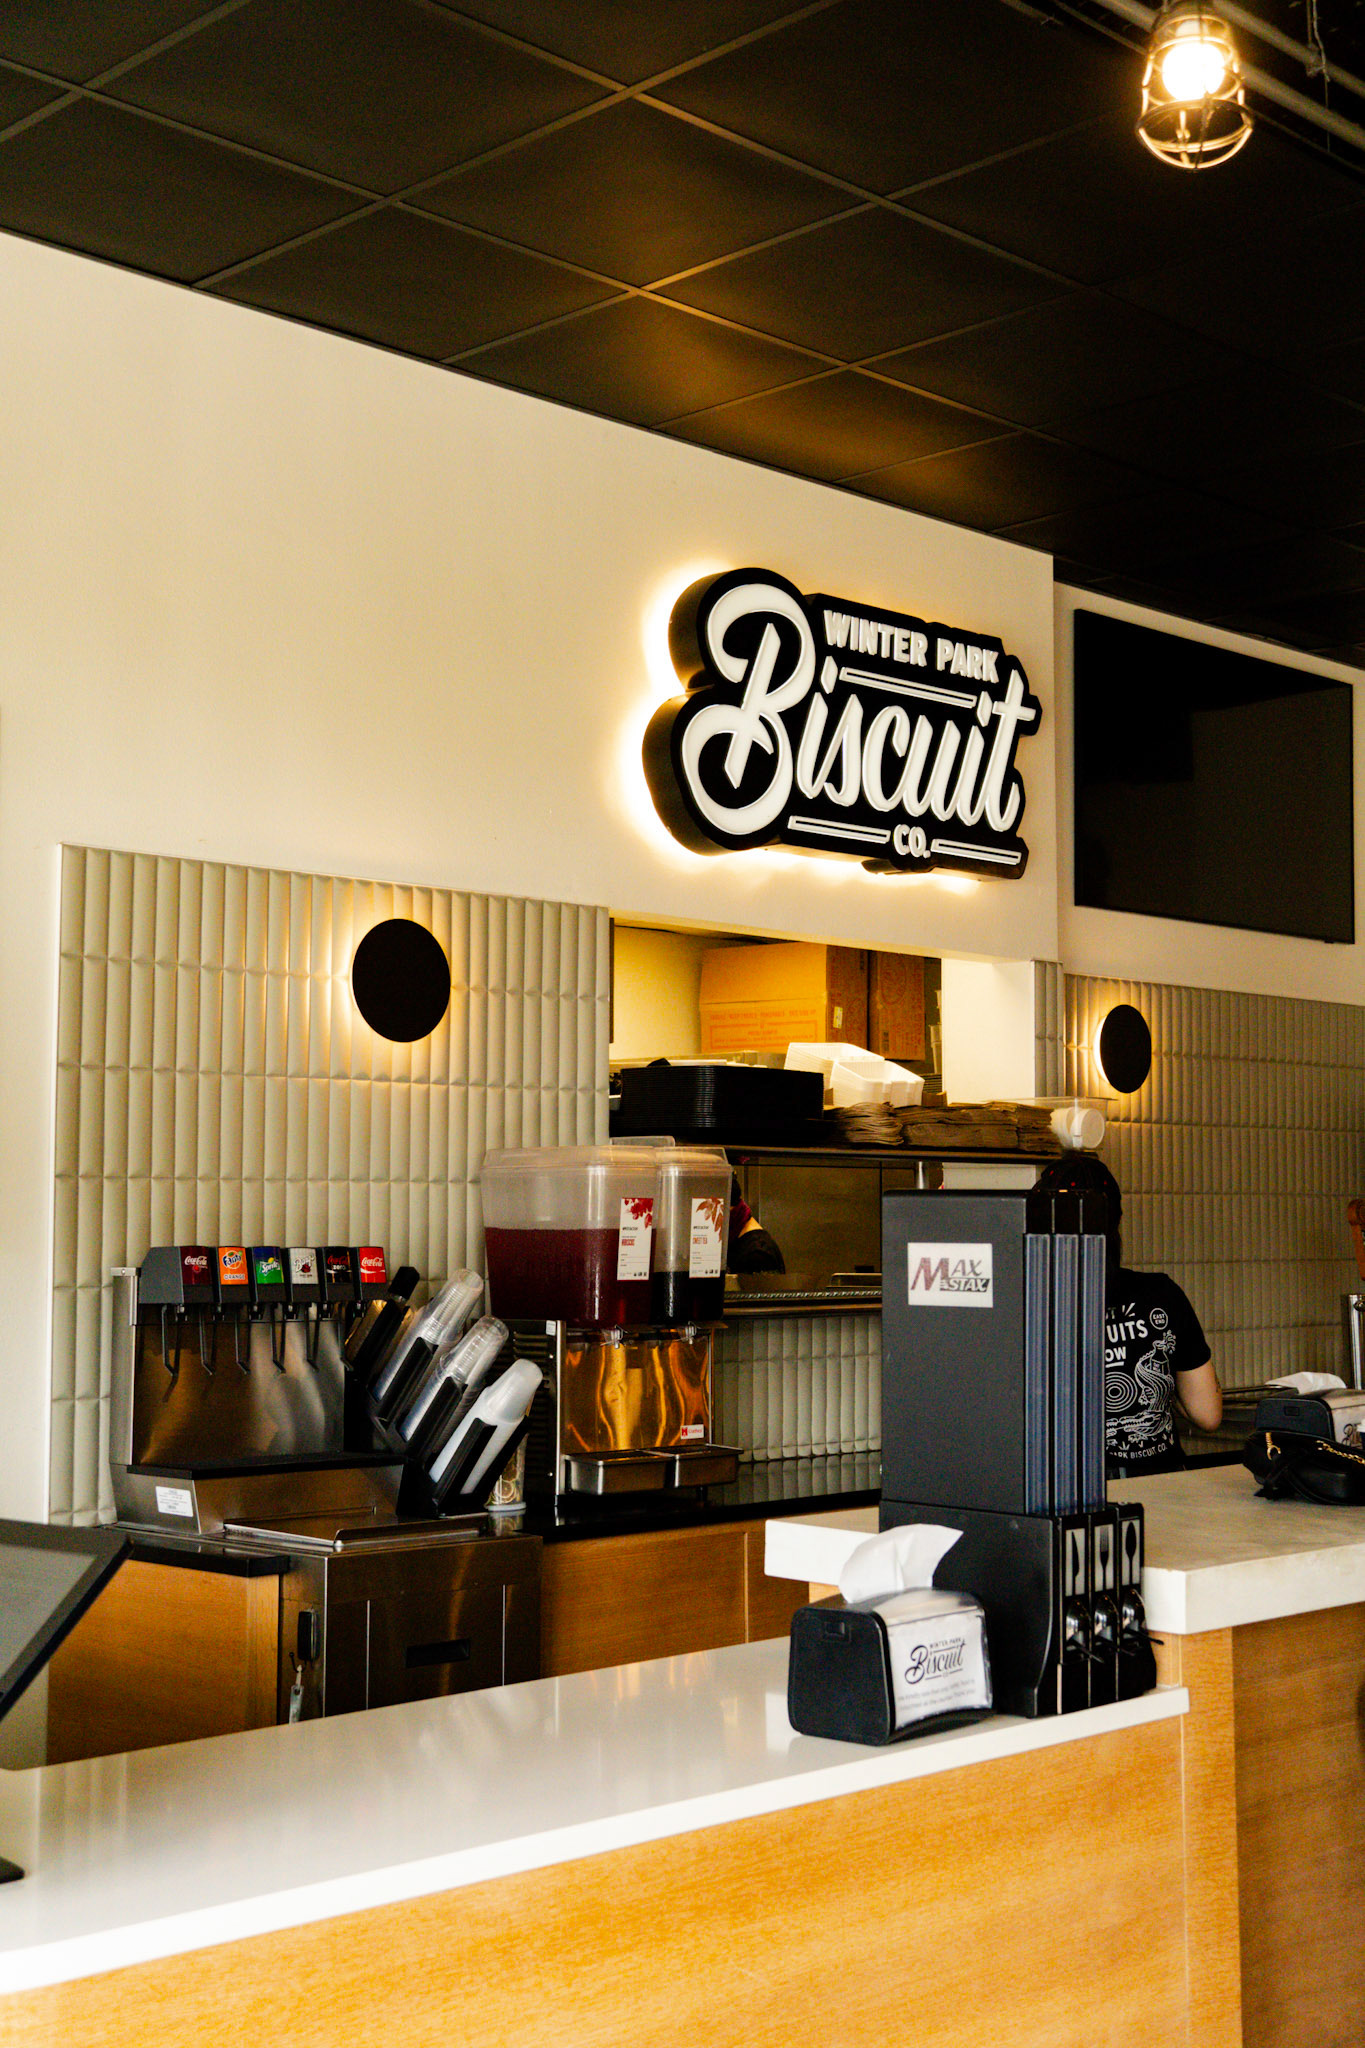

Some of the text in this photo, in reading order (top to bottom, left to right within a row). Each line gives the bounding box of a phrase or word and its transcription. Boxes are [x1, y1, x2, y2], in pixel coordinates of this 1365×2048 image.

[823, 609, 1000, 683] WINTER PARK
[681, 583, 1038, 834] Biscuit
[893, 824, 931, 858] CO.
[184, 1255, 208, 1266] Coca-Cola
[222, 1254, 242, 1267] Fanta
[261, 1261, 280, 1273] Sprite
[361, 1256, 383, 1267] Coca-Cola
[223, 1273, 246, 1281] ORANGE
[910, 1257, 983, 1291] MAX
[948, 1278, 987, 1292] STAX
[1106, 1319, 1149, 1343] UITS
[1105, 1346, 1127, 1363] OW
[1130, 1447, 1157, 1460] BISCUIT
[904, 1638, 966, 1685] Biscuit
